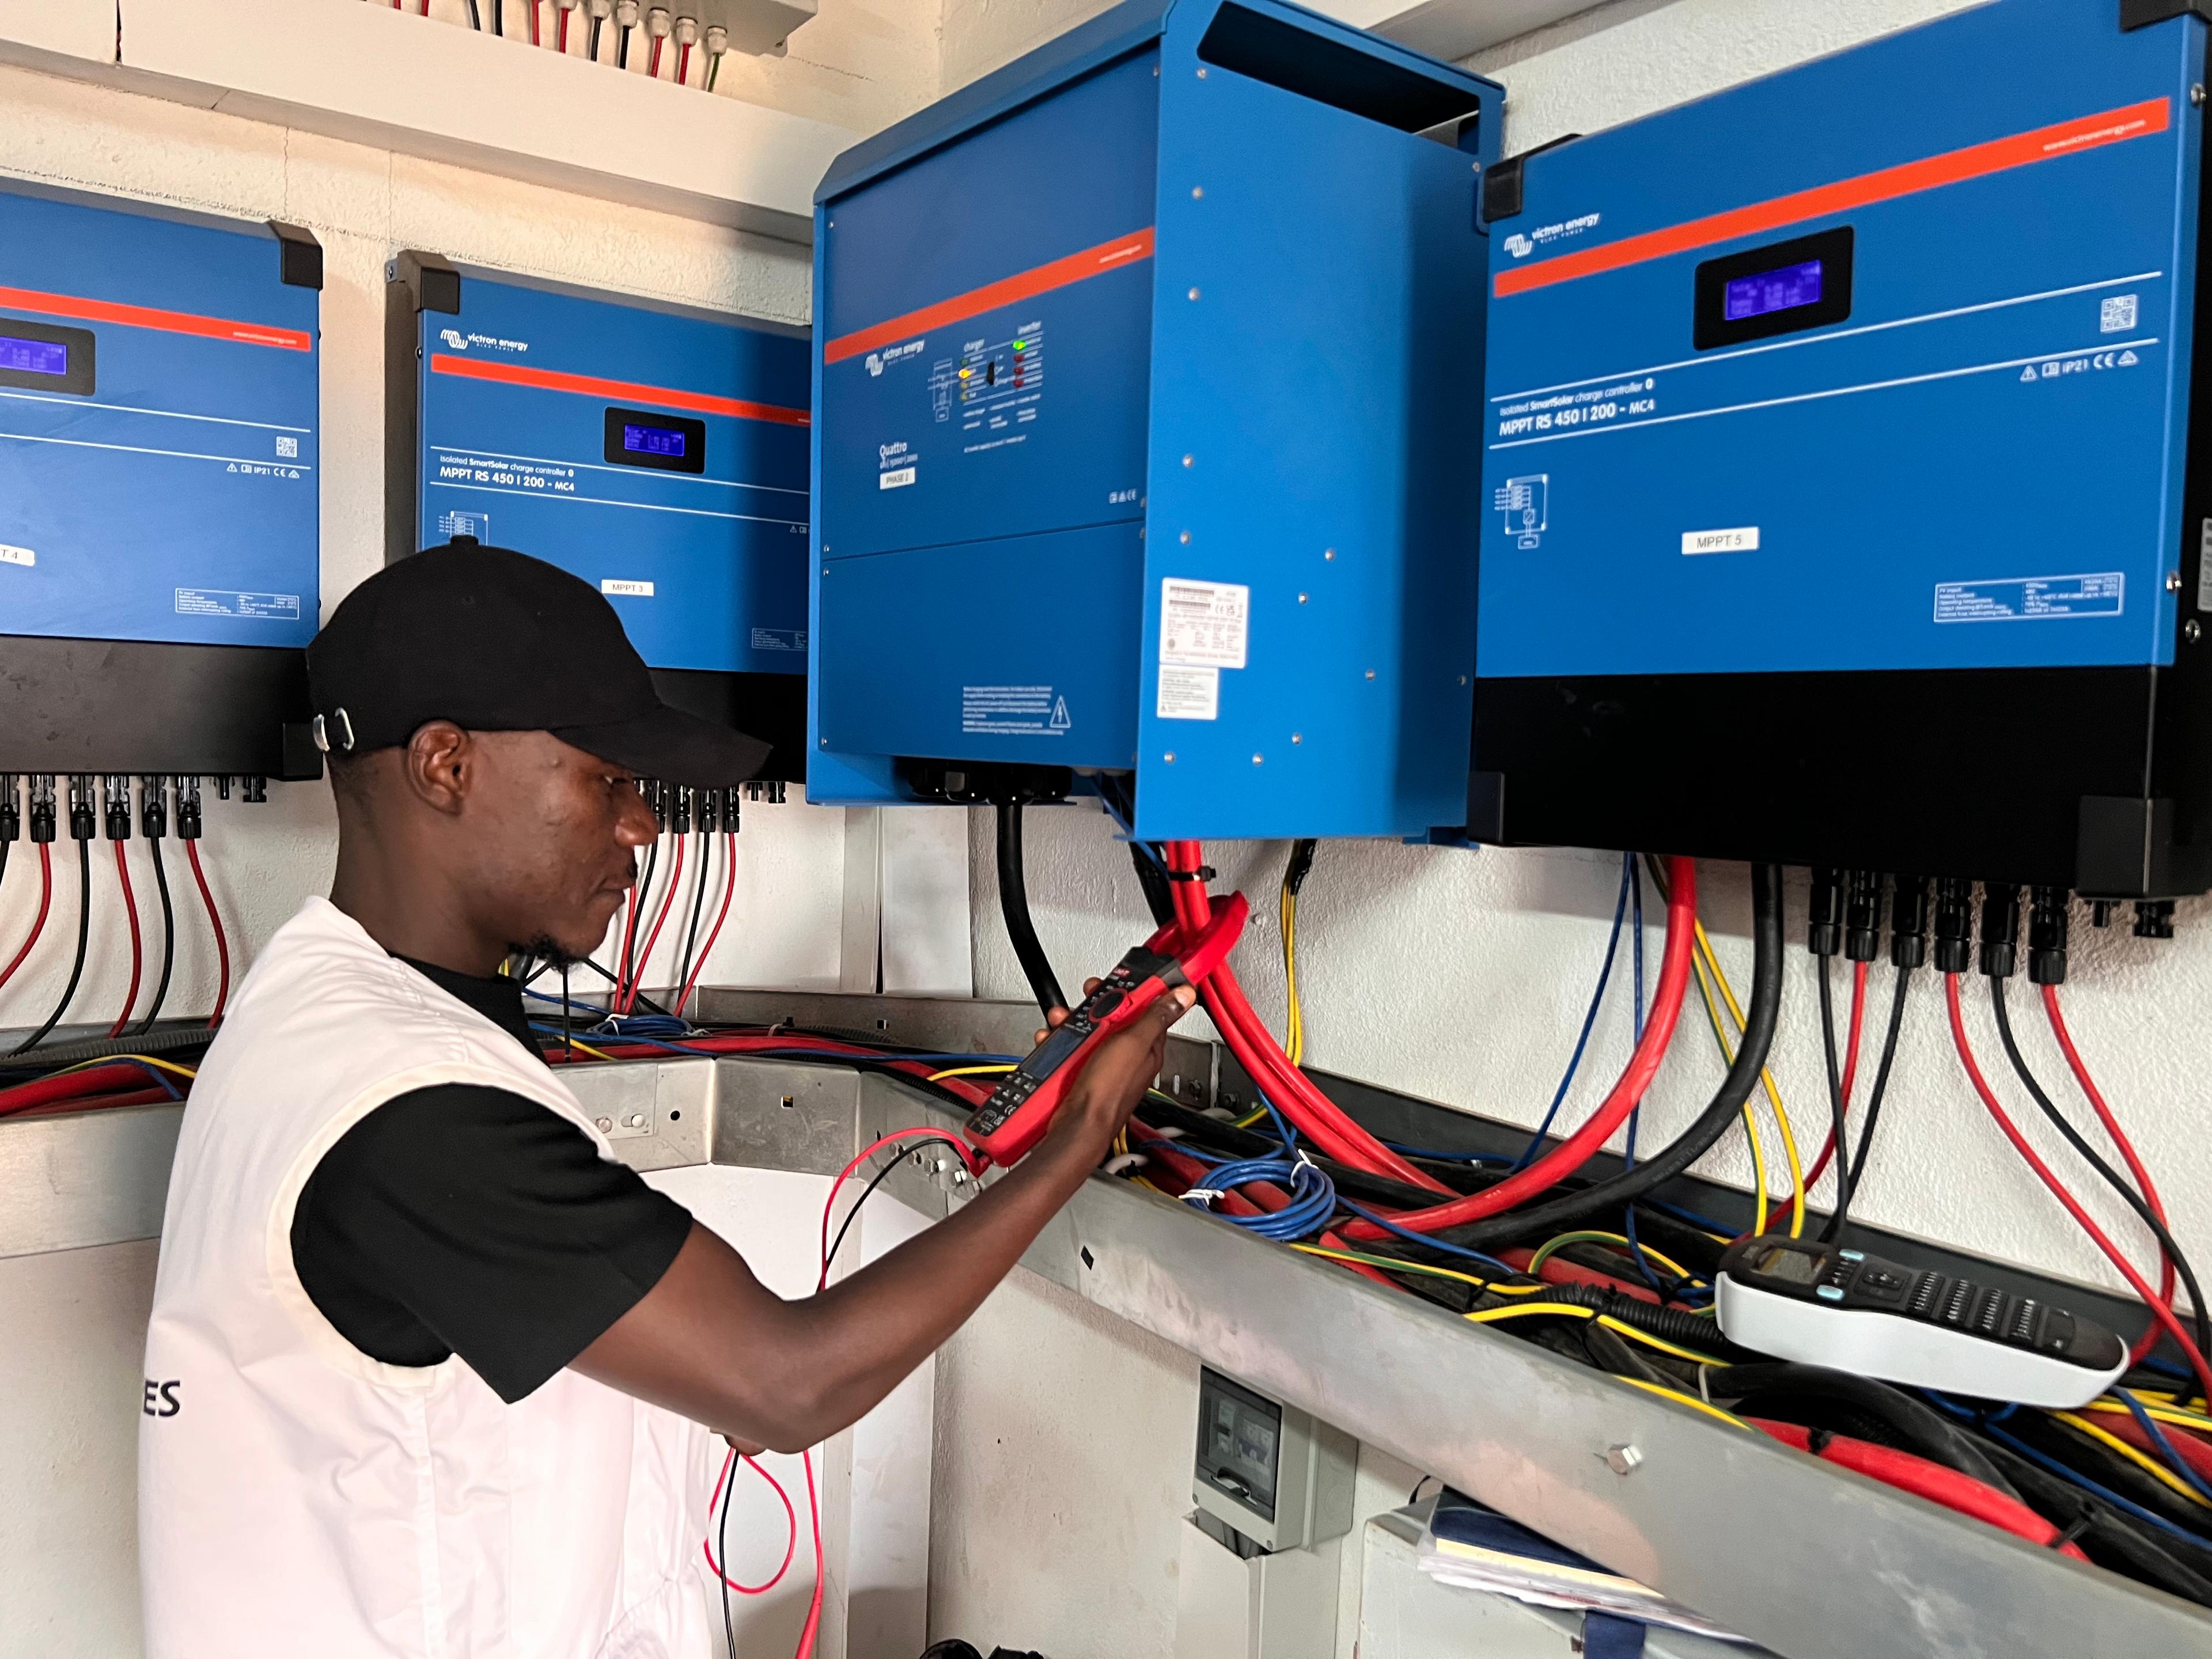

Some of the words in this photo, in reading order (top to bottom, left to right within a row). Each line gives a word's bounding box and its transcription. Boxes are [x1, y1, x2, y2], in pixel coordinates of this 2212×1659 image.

[1532, 224, 1563, 240] victron
[1566, 213, 1600, 230] energy
[468, 332, 497, 344] victron
[499, 339, 528, 351] energy
[1530, 395, 1574, 411] SmartSolar
[1575, 389, 1603, 403] charge
[1604, 382, 1642, 397] controller
[1499, 416, 1533, 436] MPPT
[1536, 414, 1551, 430] RS
[1555, 408, 1579, 426] 450
[1590, 403, 1616, 421] 200
[1629, 399, 1654, 414] MC4
[880, 442, 907, 457] Quattro
[254, 466, 270, 475] IP21
[440, 456, 468, 465] isolated
[469, 459, 509, 469] SmartSolar
[510, 464, 533, 473] charge
[535, 467, 566, 476] controller
[440, 466, 472, 479] MPPT
[475, 471, 489, 482] RS
[492, 472, 514, 484] 450
[523, 476, 545, 488] 200
[555, 481, 575, 491] MC4
[1697, 535, 1732, 548] MPPT
[1734, 534, 1742, 545] 5
[613, 584, 635, 592] MPPT
[143, 1380, 180, 1418] ES
